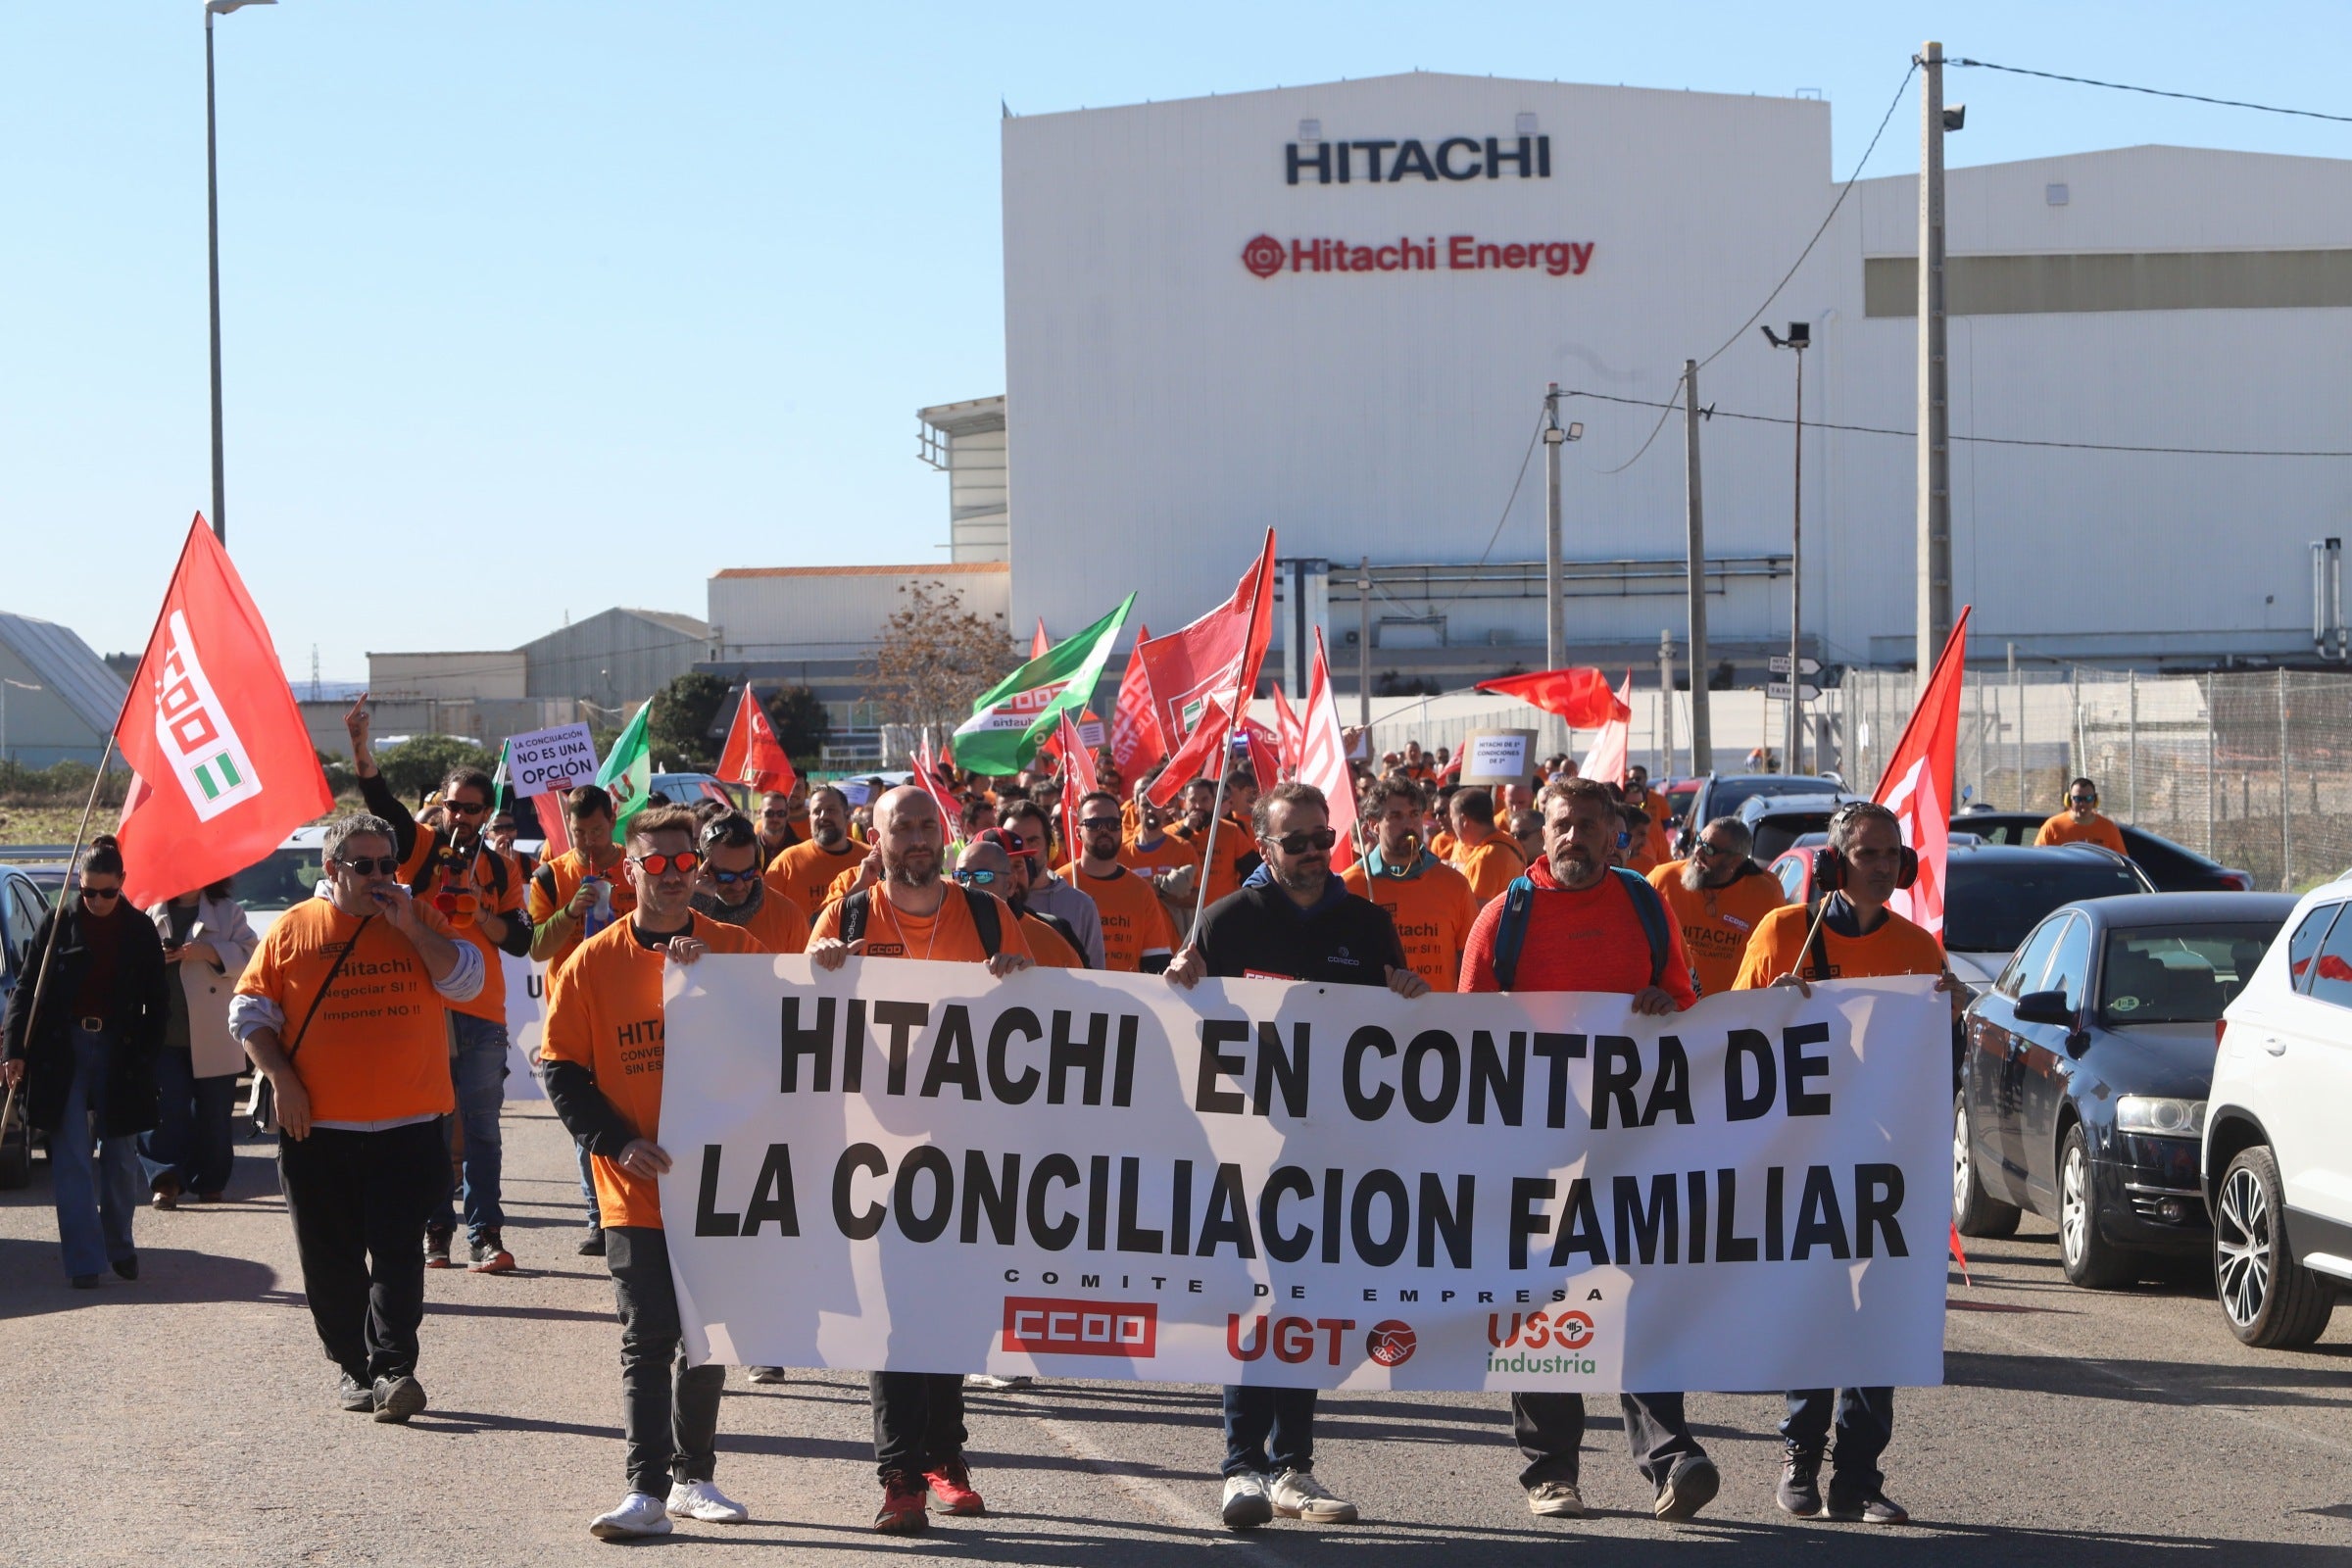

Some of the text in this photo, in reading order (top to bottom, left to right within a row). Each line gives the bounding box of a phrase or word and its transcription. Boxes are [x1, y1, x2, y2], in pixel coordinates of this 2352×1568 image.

[1285, 134, 1550, 185] HITACHI
[1291, 235, 1594, 276] Hitachi Energy
[514, 730, 583, 750] LA CONCILIACIÓN
[516, 742, 588, 764] NO ES UNA
[522, 758, 593, 785] OPCIÓN
[1327, 956, 1359, 966] CORECO
[1420, 945, 1430, 954] SI
[335, 957, 413, 978] Hitachi
[323, 984, 386, 999] Negociar
[392, 981, 404, 993] SI
[323, 1006, 382, 1021] Imponer
[387, 1004, 409, 1016] NO
[625, 1062, 644, 1076] SIN
[780, 996, 1832, 1130] HITACHI EN CONTRA DE
[694, 1142, 1910, 1270] LA CONCILIACION FAMILIAR
[1004, 1268, 1604, 1304] COMITE DE EMPRESA
[1010, 1307, 1594, 1367] CCOO UGT USO
[1486, 1350, 1597, 1375] industria
